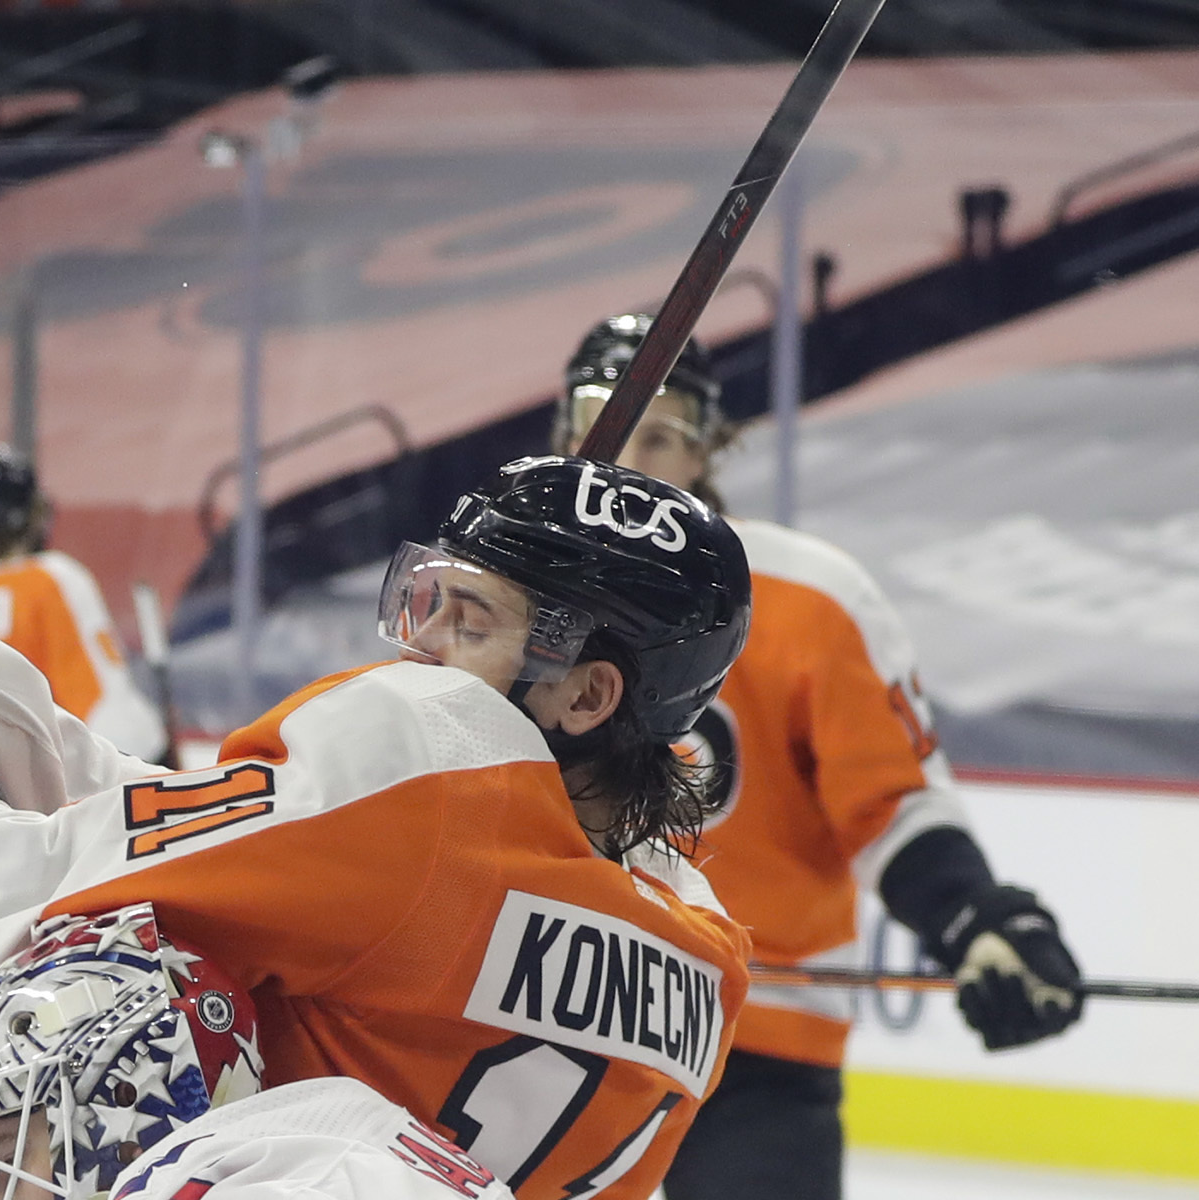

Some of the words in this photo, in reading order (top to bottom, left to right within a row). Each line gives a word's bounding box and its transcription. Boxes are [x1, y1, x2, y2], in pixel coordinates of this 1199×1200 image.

[717, 191, 748, 239] FT3
[575, 463, 690, 553] tcs
[123, 763, 276, 861] 11
[498, 911, 716, 1078] KONECNY
